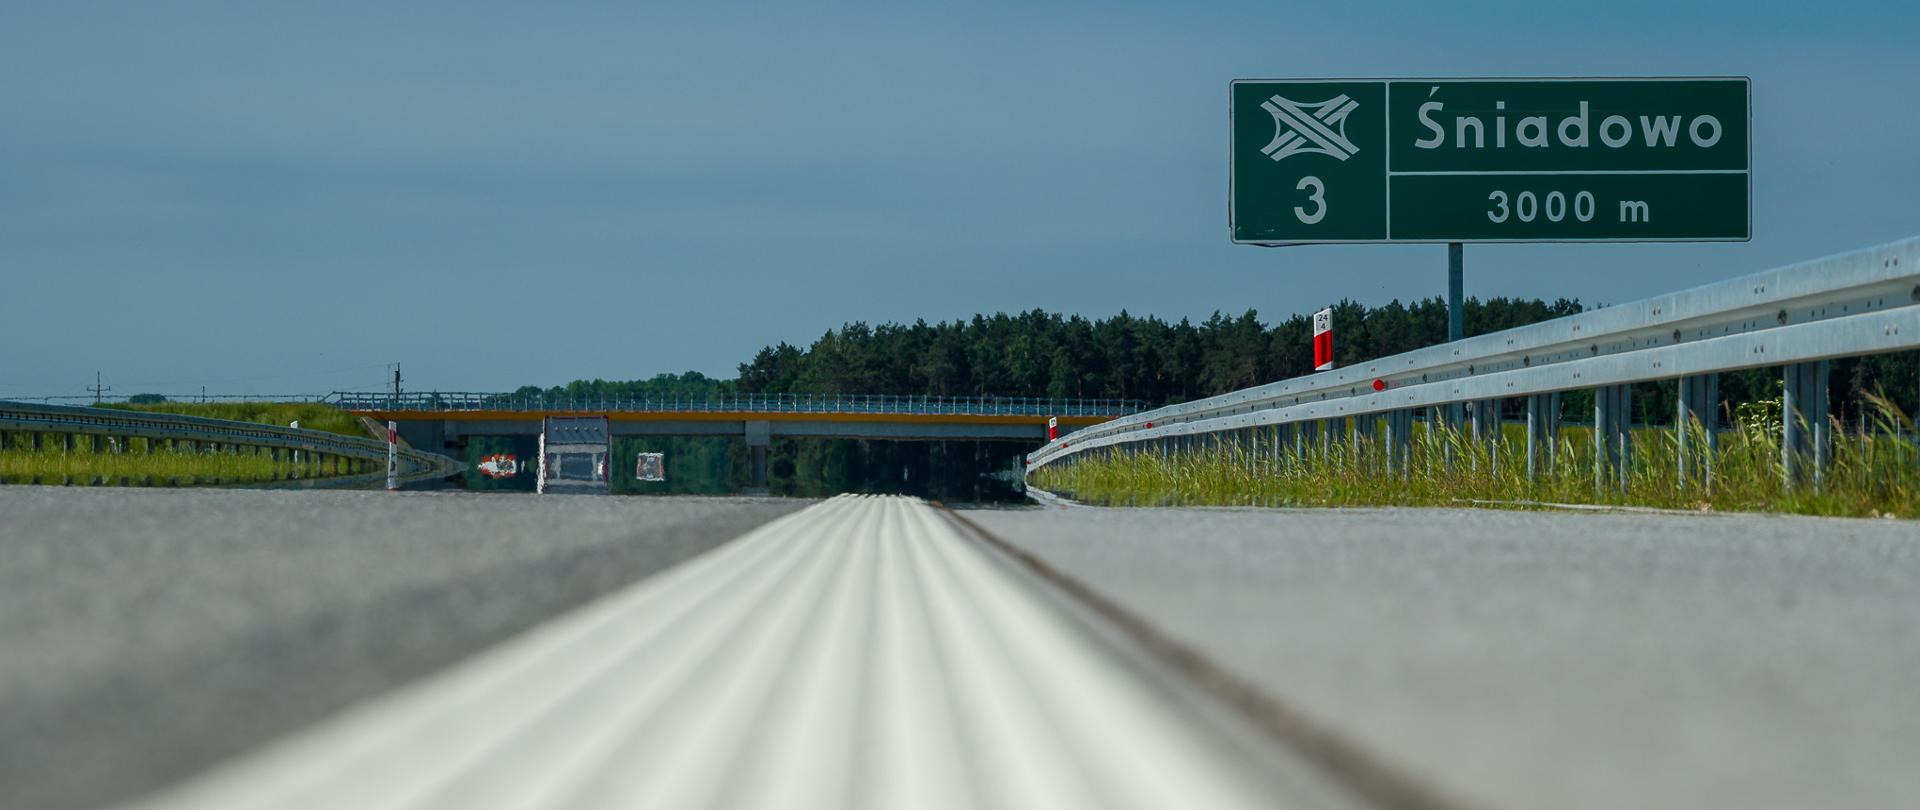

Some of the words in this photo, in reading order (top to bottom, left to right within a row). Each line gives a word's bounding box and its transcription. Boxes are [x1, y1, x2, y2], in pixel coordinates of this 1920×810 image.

[1415, 86, 1723, 149] Śniadowo
[1294, 175, 1327, 225] 3
[1487, 190, 1596, 223] 3000
[1619, 197, 1650, 222] m
